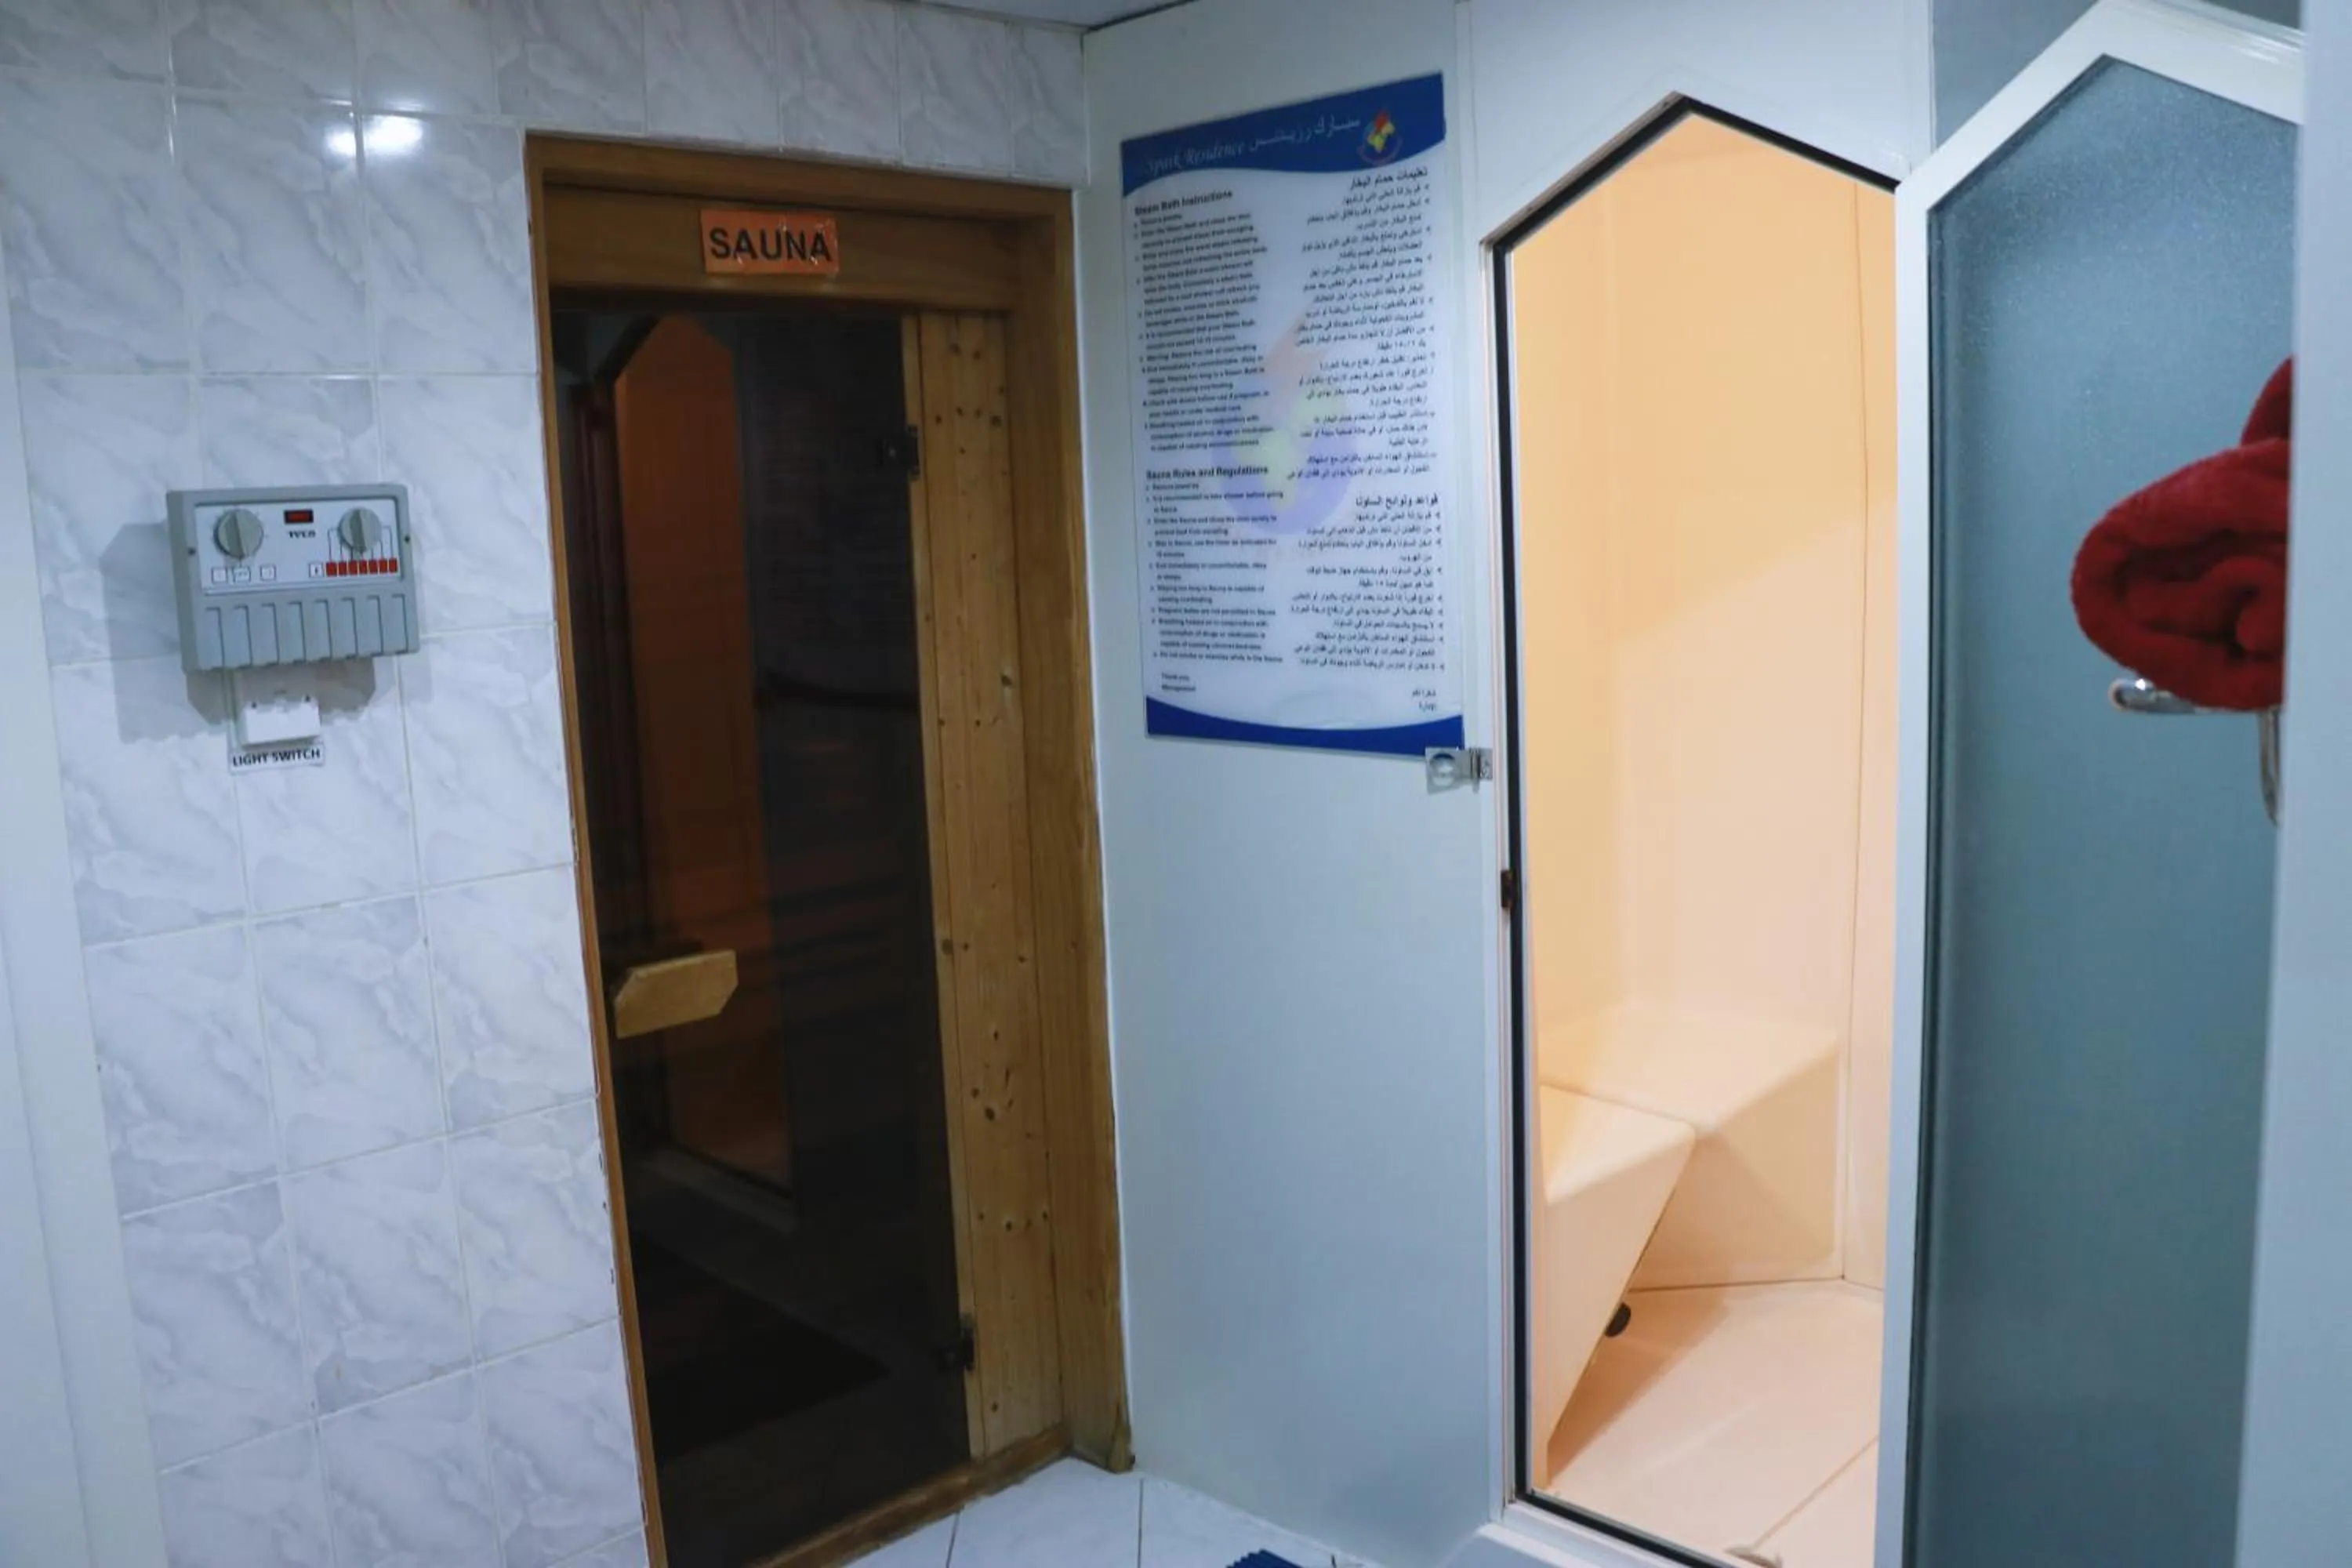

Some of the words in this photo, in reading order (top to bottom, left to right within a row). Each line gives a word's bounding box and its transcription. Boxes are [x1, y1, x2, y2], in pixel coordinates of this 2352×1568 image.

[1181, 190, 1233, 206] Instructions
[709, 227, 833, 262] SAUNA
[233, 751, 269, 767] LIGHT
[271, 747, 321, 763] SWITCH
